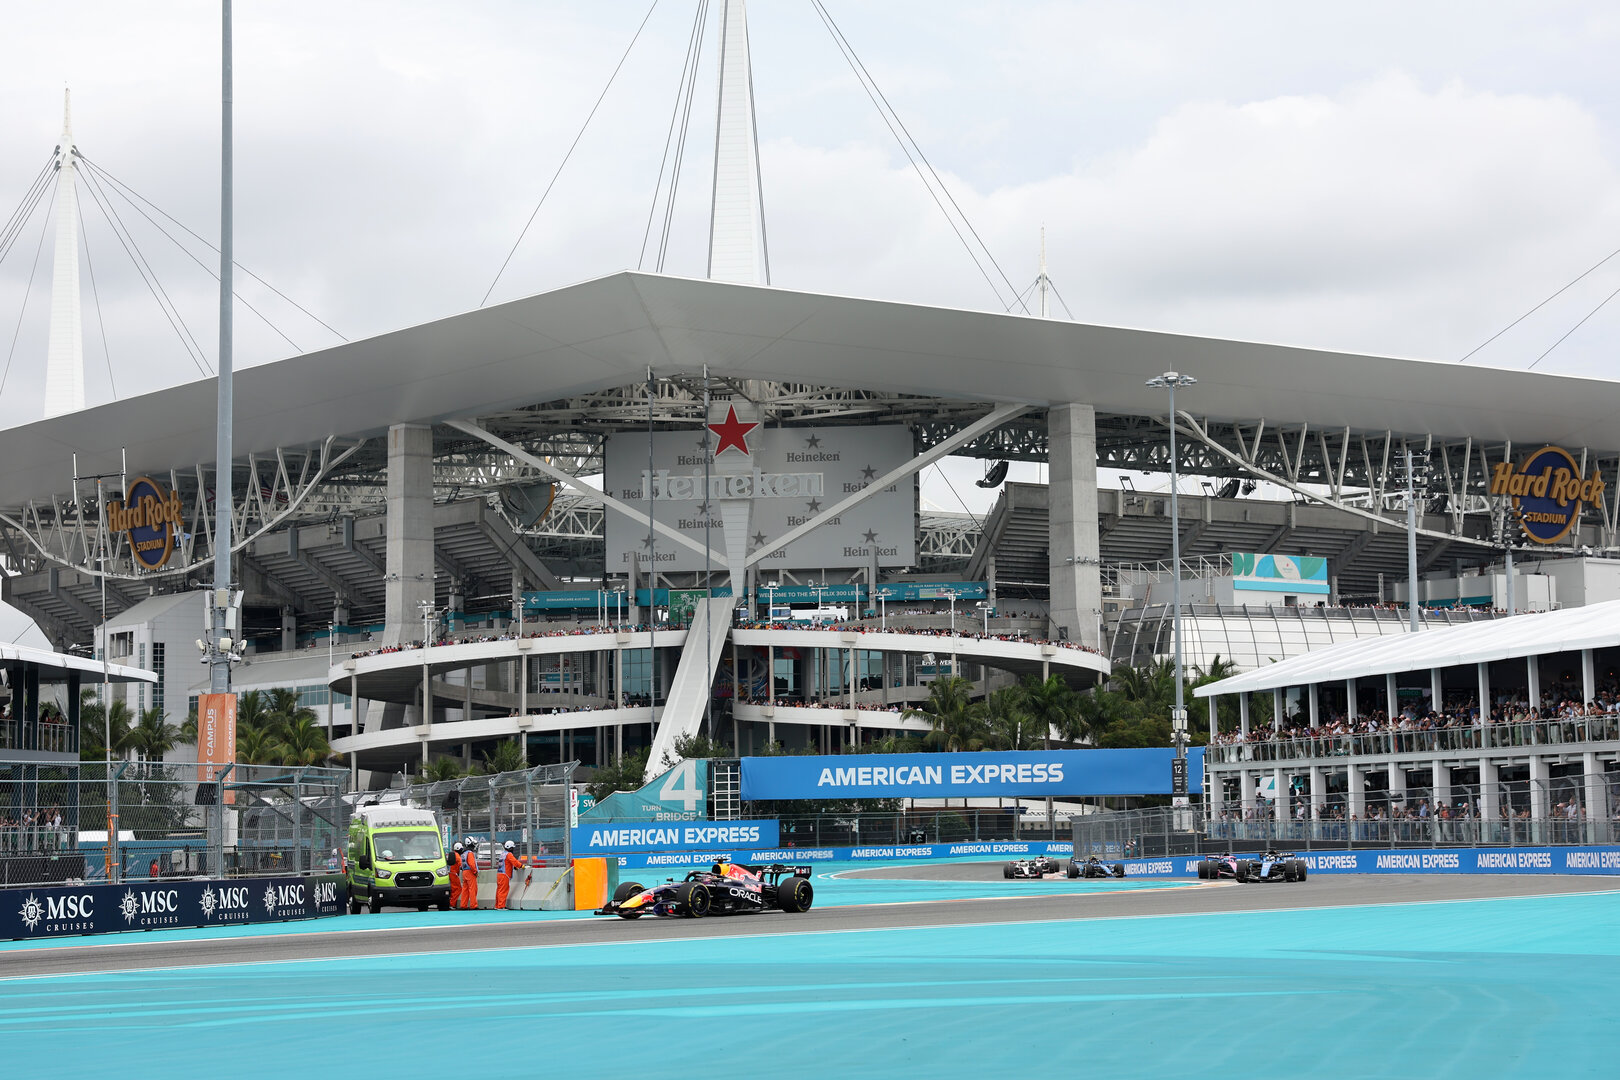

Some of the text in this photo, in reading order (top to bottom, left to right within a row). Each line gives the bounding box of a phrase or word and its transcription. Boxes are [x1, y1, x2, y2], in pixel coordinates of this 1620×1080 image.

[786, 452, 840, 462] Heineken
[642, 466, 822, 500] Heineken
[1490, 462, 1605, 509] Hard Rock
[107, 490, 184, 533] Hard Rock
[1526, 512, 1566, 524] STADIUM
[678, 519, 724, 529] Heineke
[136, 538, 164, 552] STADIUM
[843, 547, 897, 556] Heinken
[623, 552, 676, 562] Hineken
[817, 763, 1063, 787] AMERICAN EXPRESS
[1174, 765, 1182, 773] 12
[660, 759, 702, 811] 4
[656, 812, 696, 821] BRIDGE
[589, 827, 759, 847] AMERICAN EXPRESS
[751, 850, 833, 861] AMERICAN EXPRESS
[851, 848, 932, 858] AMERICAN EXPRESS
[950, 844, 1028, 854] AMERICAN EXPRESS
[646, 855, 691, 864] AMERICAN
[1318, 856, 1357, 869] EXPRESS
[1376, 854, 1459, 868] AMERICAN EXPRESS
[1477, 853, 1551, 868] AMERICAN EXPRESS
[1566, 852, 1620, 868] AMERICAN EXPRE
[1124, 863, 1147, 874] AMERICAN
[1148, 861, 1173, 873] EXPRESS
[219, 887, 249, 909] MSC
[278, 885, 305, 905] MSC
[322, 882, 336, 902] MSC
[730, 888, 762, 904] ORACLE
[46, 894, 94, 919] MSC
[141, 890, 178, 913] MSC
[141, 916, 178, 925] CRUISES
[218, 912, 249, 920] CRUISES
[46, 922, 94, 932] CRUISES
